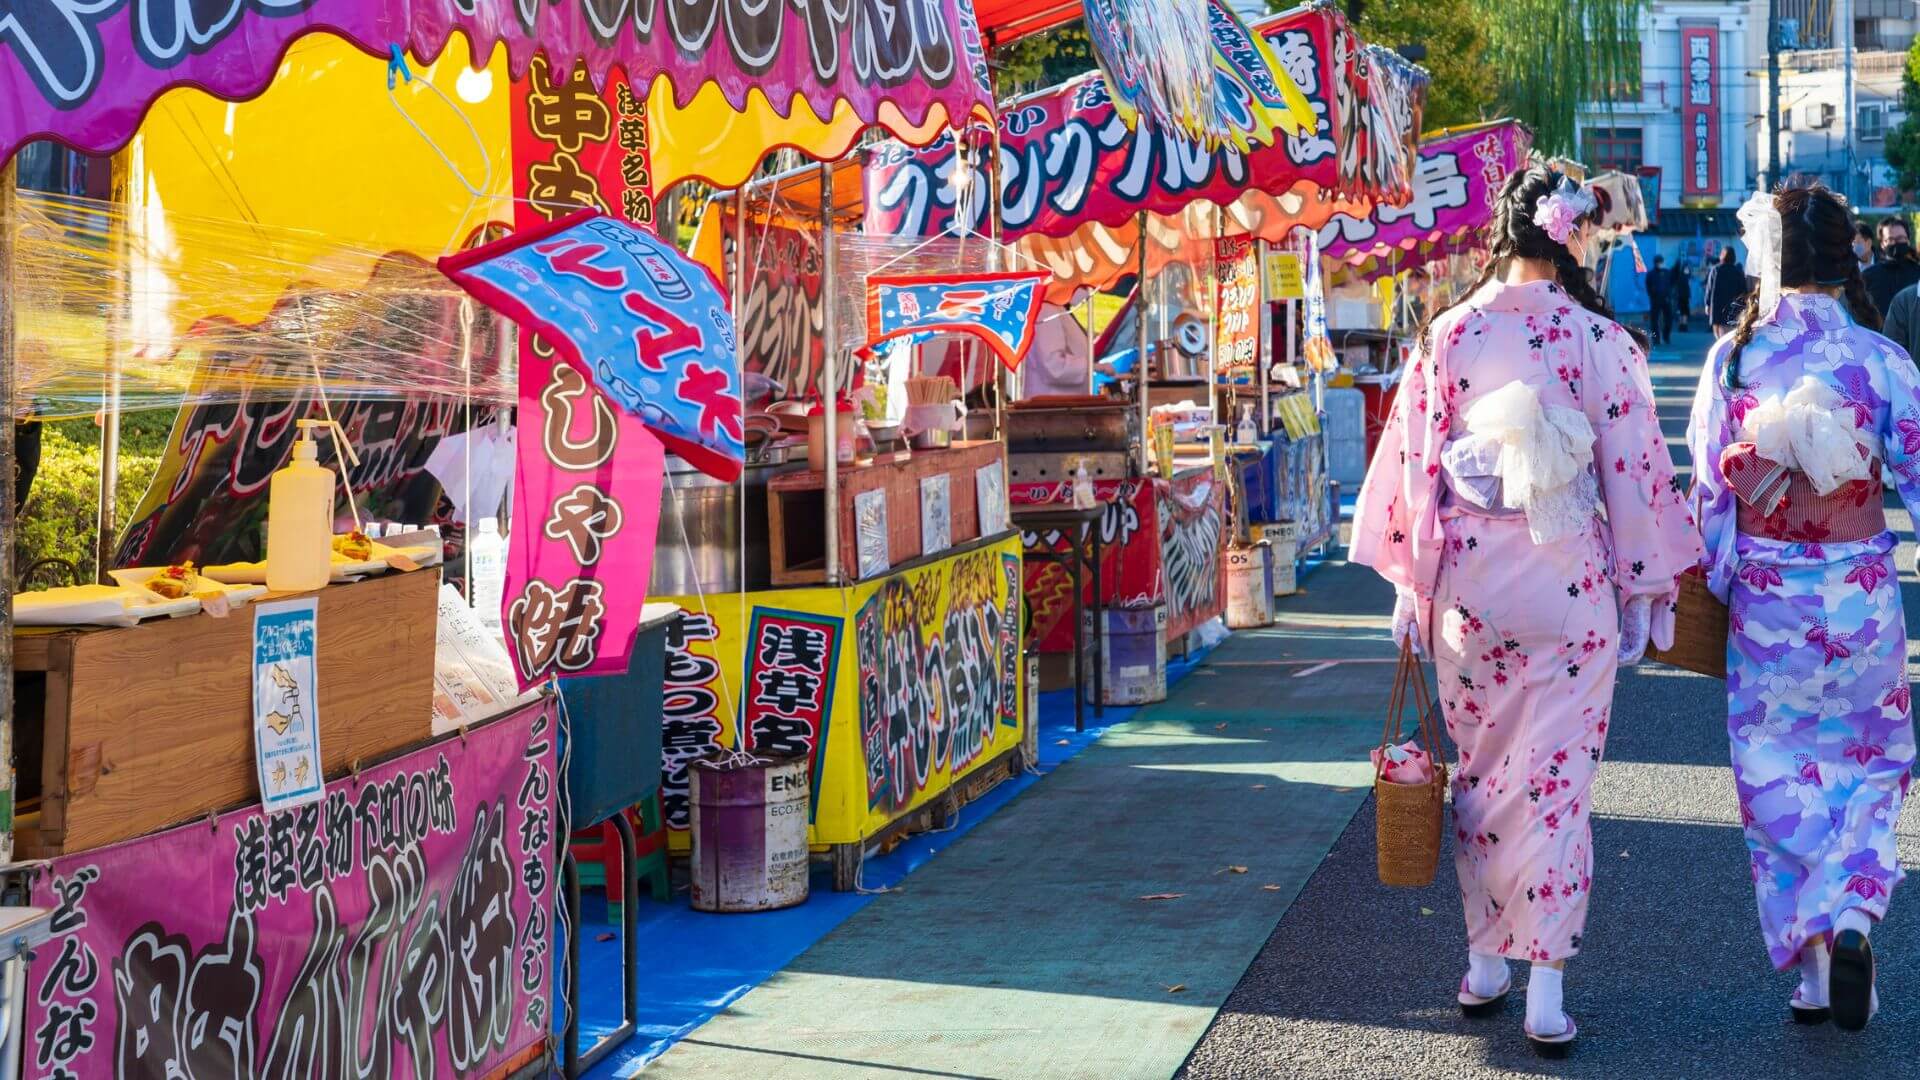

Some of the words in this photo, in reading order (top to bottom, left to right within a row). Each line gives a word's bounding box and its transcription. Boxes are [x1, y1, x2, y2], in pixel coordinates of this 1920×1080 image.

[517, 709, 552, 1031] こんなもんじゃ
